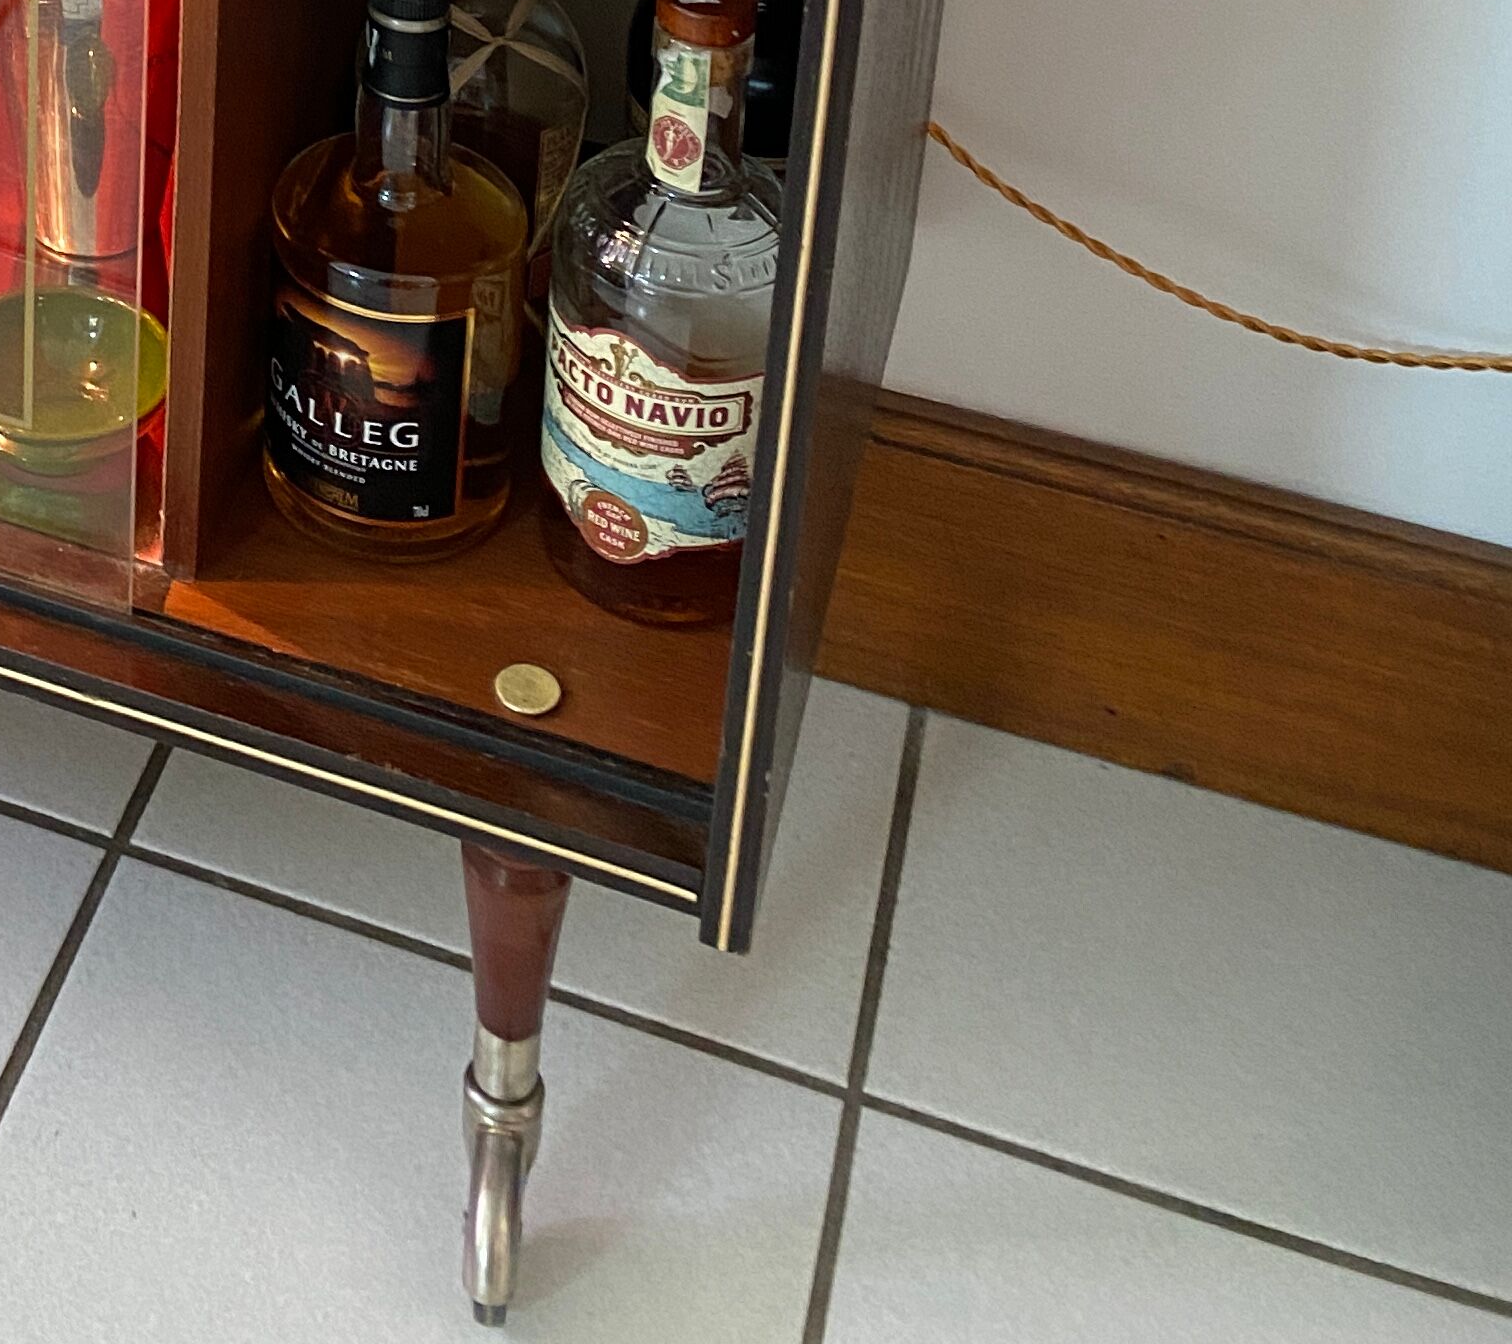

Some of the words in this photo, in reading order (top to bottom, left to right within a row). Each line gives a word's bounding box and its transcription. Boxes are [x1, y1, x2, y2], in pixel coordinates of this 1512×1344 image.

[270, 357, 420, 449] GALLEG
[624, 393, 729, 429] NAVIO
[328, 443, 419, 472] BRETAGNE
[587, 509, 609, 529] RED
[609, 522, 641, 543] WINE
